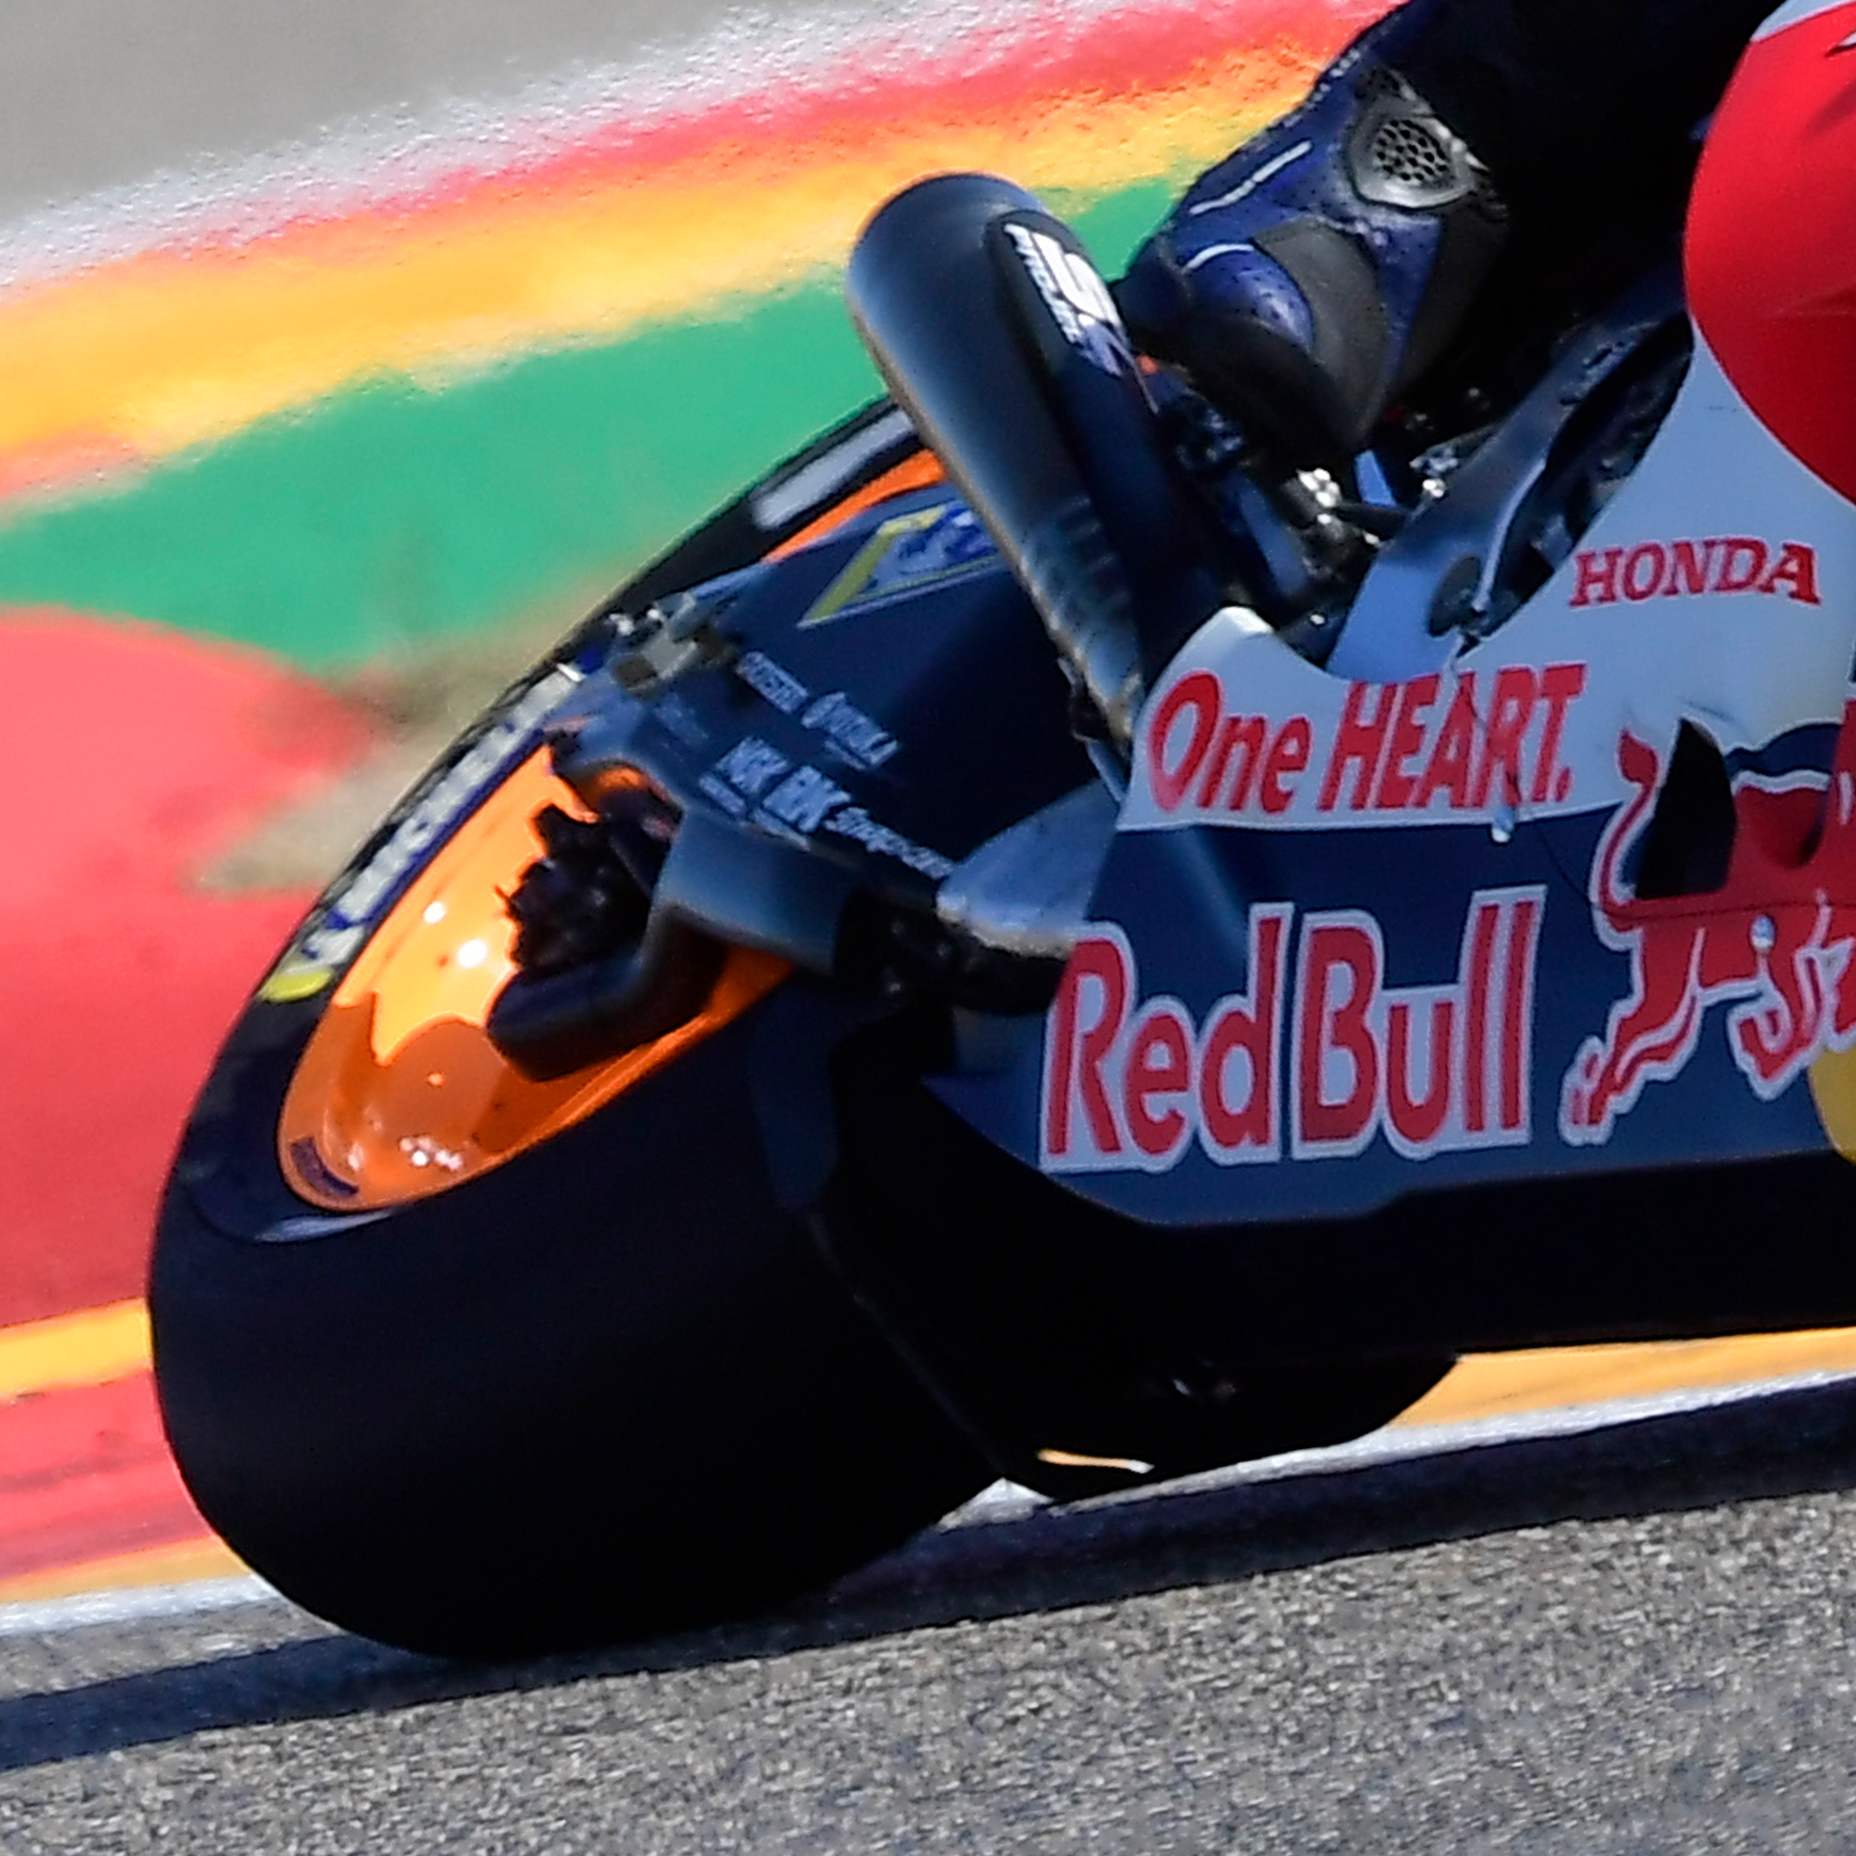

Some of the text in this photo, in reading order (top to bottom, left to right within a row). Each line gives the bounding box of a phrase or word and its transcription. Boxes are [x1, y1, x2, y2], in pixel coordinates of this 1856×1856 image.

[1567, 535, 1823, 609] HONDA
[1145, 661, 1589, 814] One HEART.
